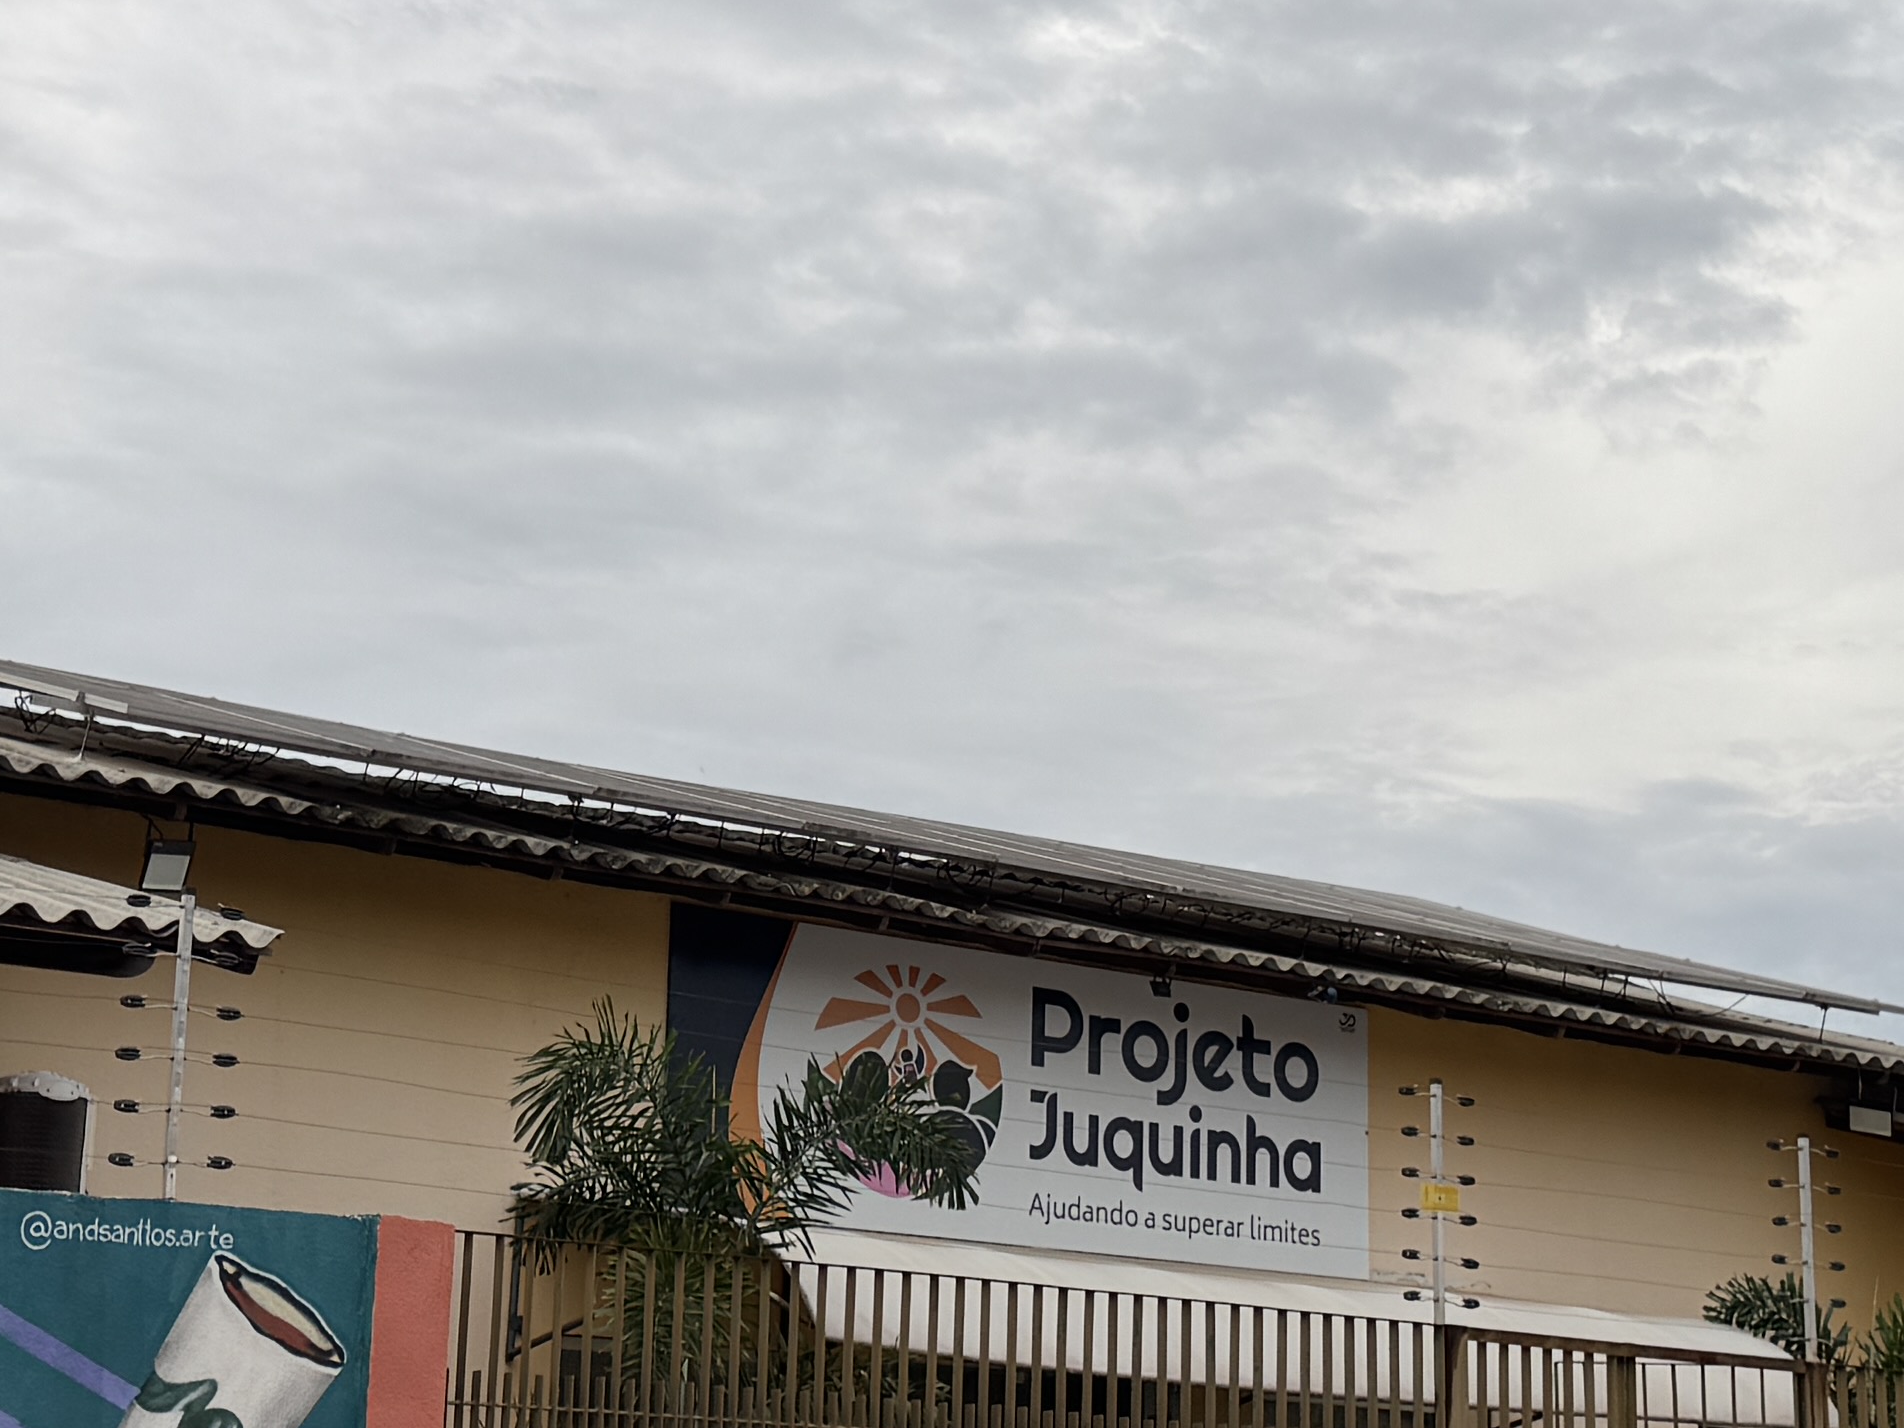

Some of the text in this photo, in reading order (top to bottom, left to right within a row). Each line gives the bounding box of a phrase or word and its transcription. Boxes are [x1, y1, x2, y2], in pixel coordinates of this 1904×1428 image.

[1031, 985, 1320, 1106] Projeto
[1029, 1089, 1322, 1193] Juquinha
[1029, 1193, 1321, 1247] Ajudando a superar limites
